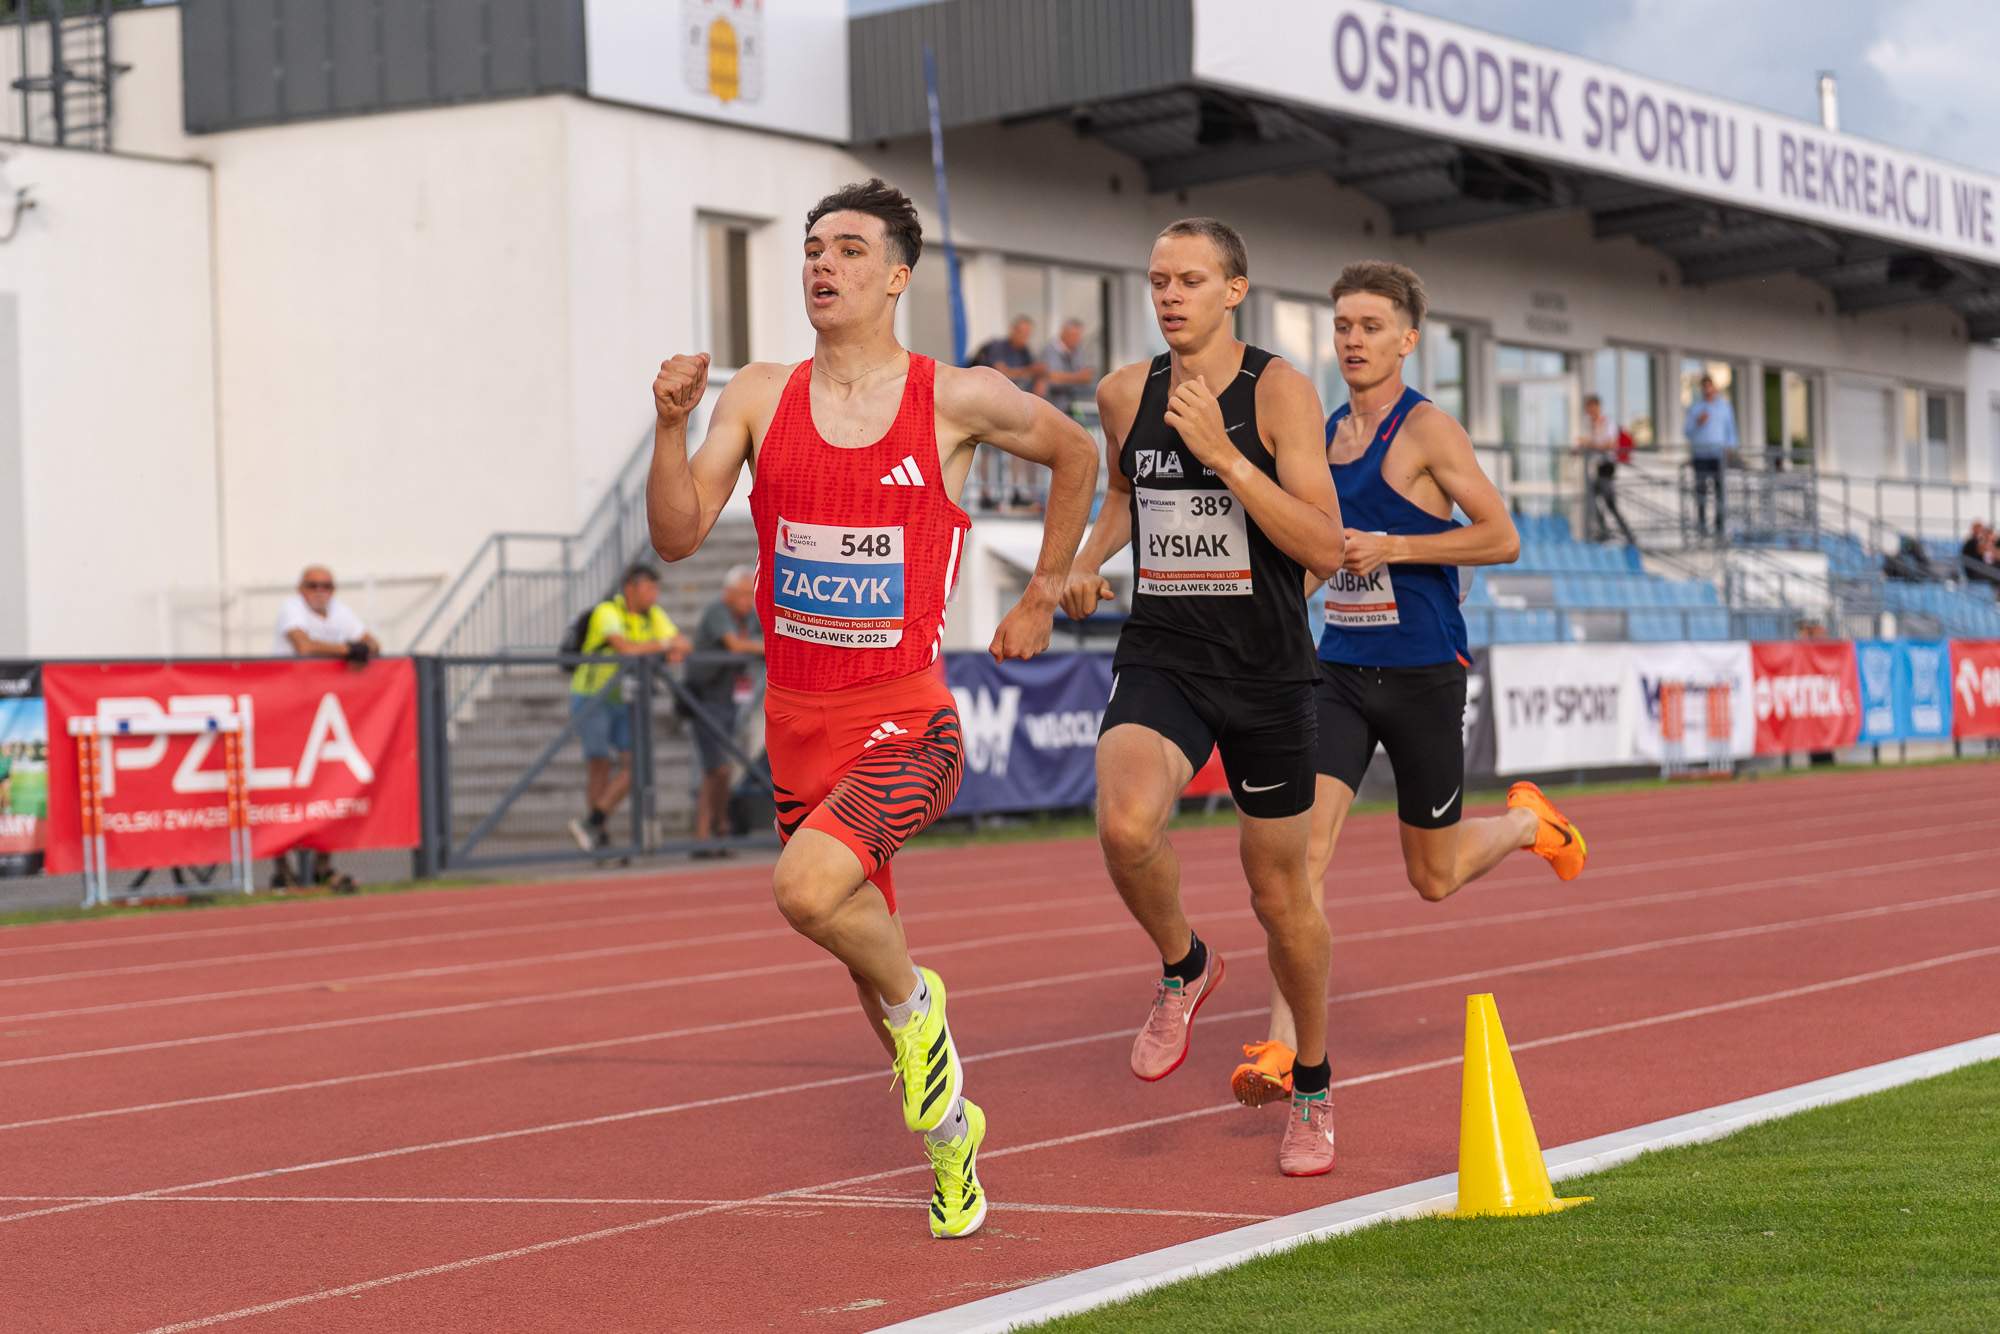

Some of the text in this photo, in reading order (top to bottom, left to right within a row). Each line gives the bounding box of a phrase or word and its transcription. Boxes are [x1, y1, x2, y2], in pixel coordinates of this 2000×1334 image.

[1334, 9, 1994, 244] OŚRODEK SPORTU I REKREACJI WE
[1190, 495, 1233, 516] 389
[840, 533, 891, 557] 548
[1149, 533, 1231, 557] ŁYSIAK
[781, 568, 891, 604] ZACZYK
[1148, 583, 1238, 592] WŁOCŁAWEK 2025
[1328, 571, 1384, 592] UBAK
[792, 612, 807, 622] PZLA
[807, 616, 850, 628] Mistrzostwa
[851, 619, 875, 628] Polski
[875, 620, 891, 628] U20
[785, 623, 887, 643] WŁOCŁAWEK 2025
[96, 692, 375, 798] PZLA
